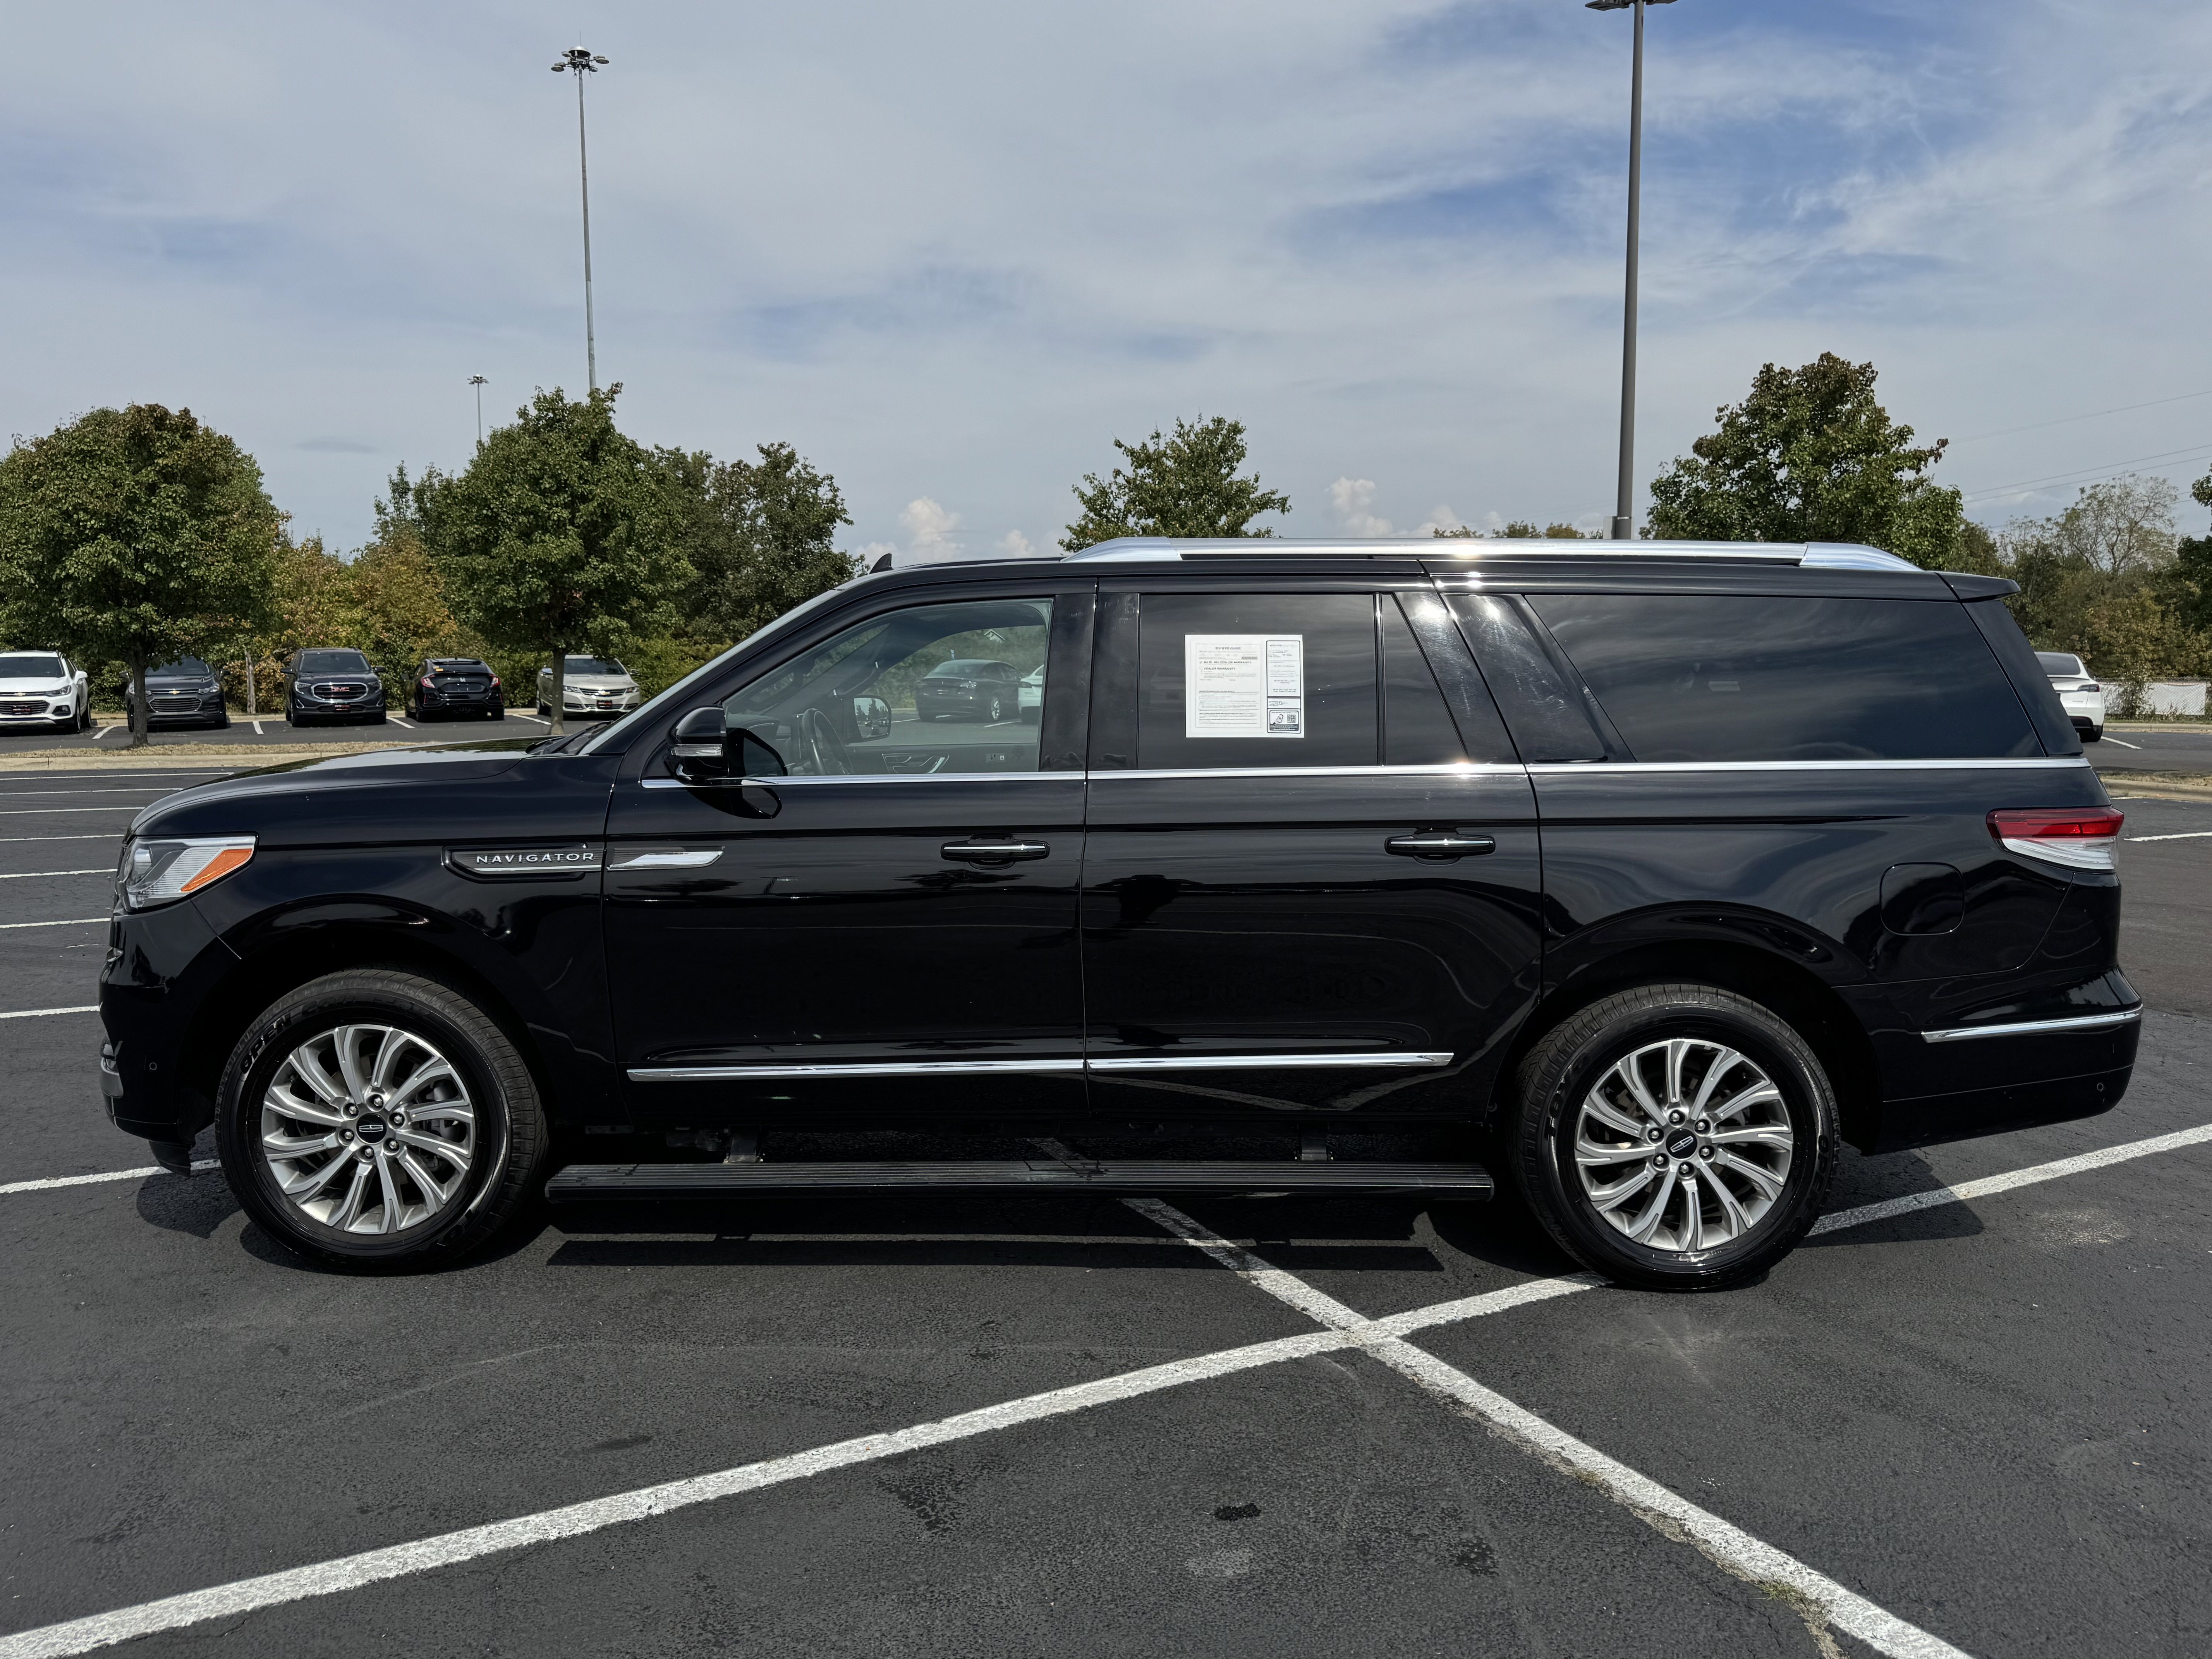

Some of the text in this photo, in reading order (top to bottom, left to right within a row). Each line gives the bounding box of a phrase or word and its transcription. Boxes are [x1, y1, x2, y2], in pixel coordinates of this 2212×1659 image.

[476, 853, 595, 864] NAVIGATOR
[239, 1013, 292, 1074] OPEN
[1543, 1052, 1591, 1140] TOYO
